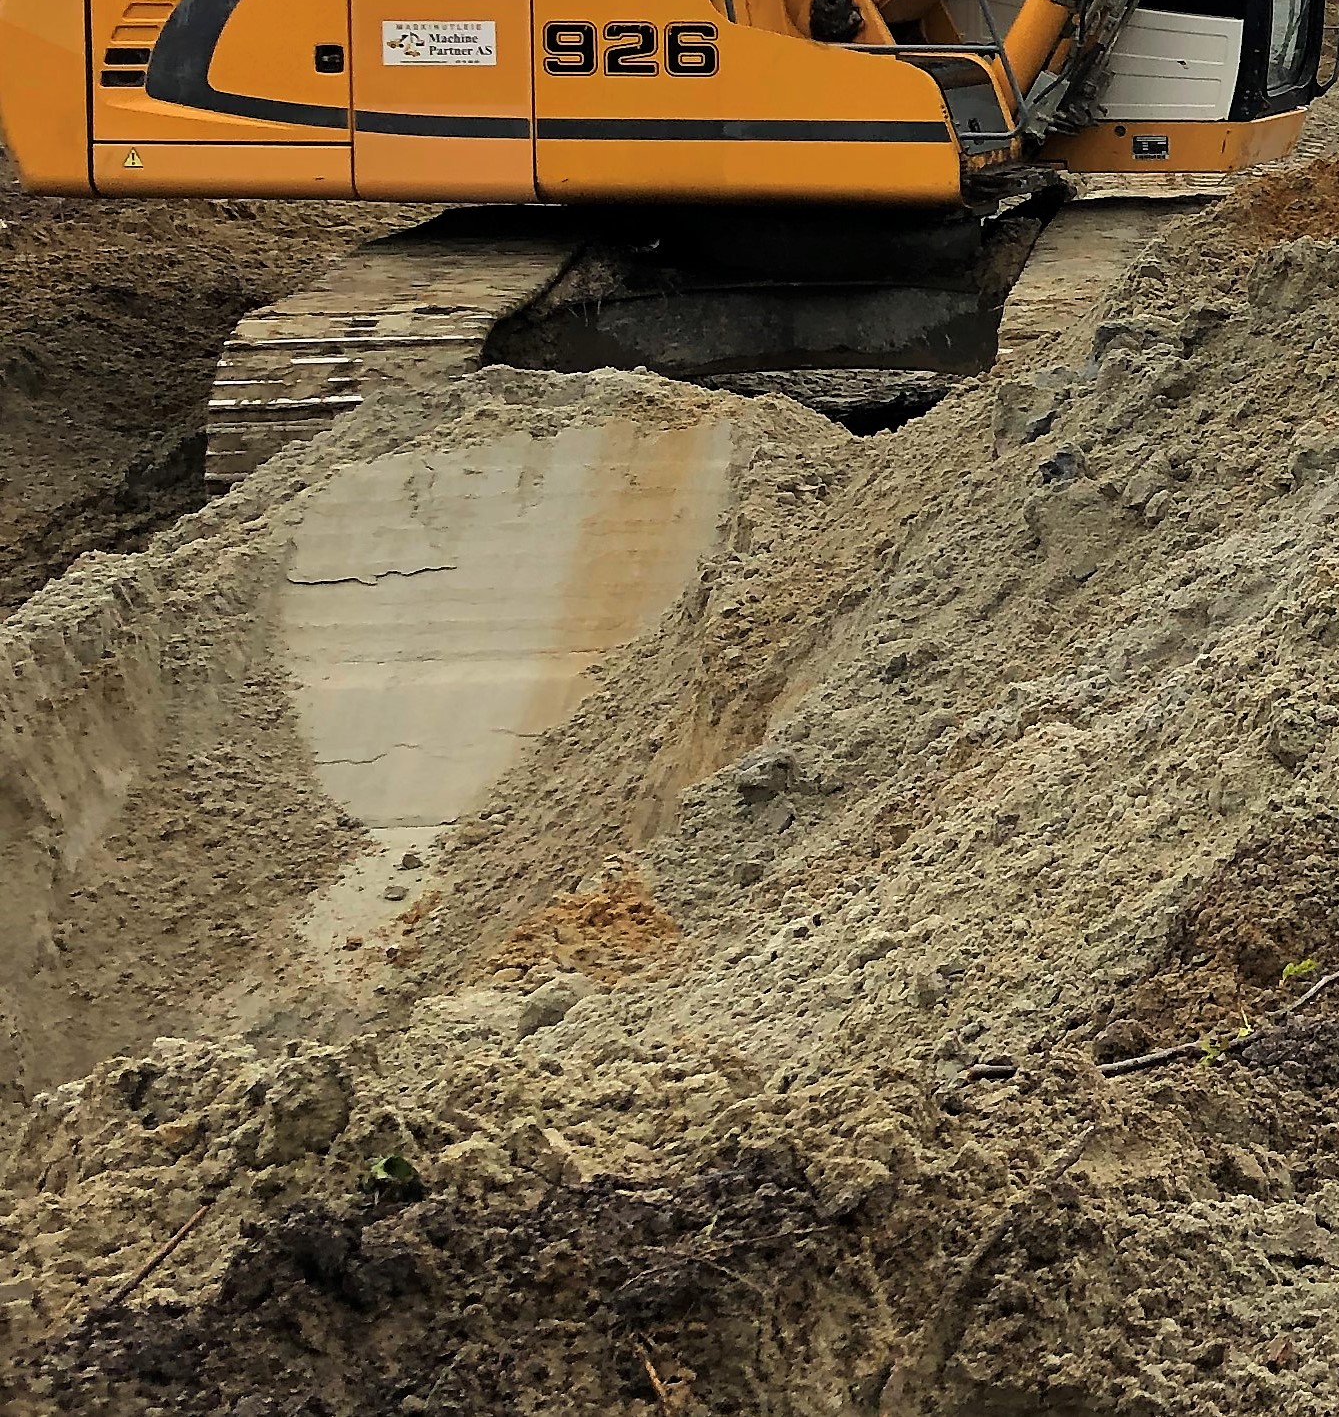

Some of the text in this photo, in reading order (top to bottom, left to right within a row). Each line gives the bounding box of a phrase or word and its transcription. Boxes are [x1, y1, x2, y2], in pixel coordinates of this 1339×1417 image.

[429, 33, 479, 44] Machine
[429, 45, 493, 56] Partner AS
[543, 20, 720, 77] 926
